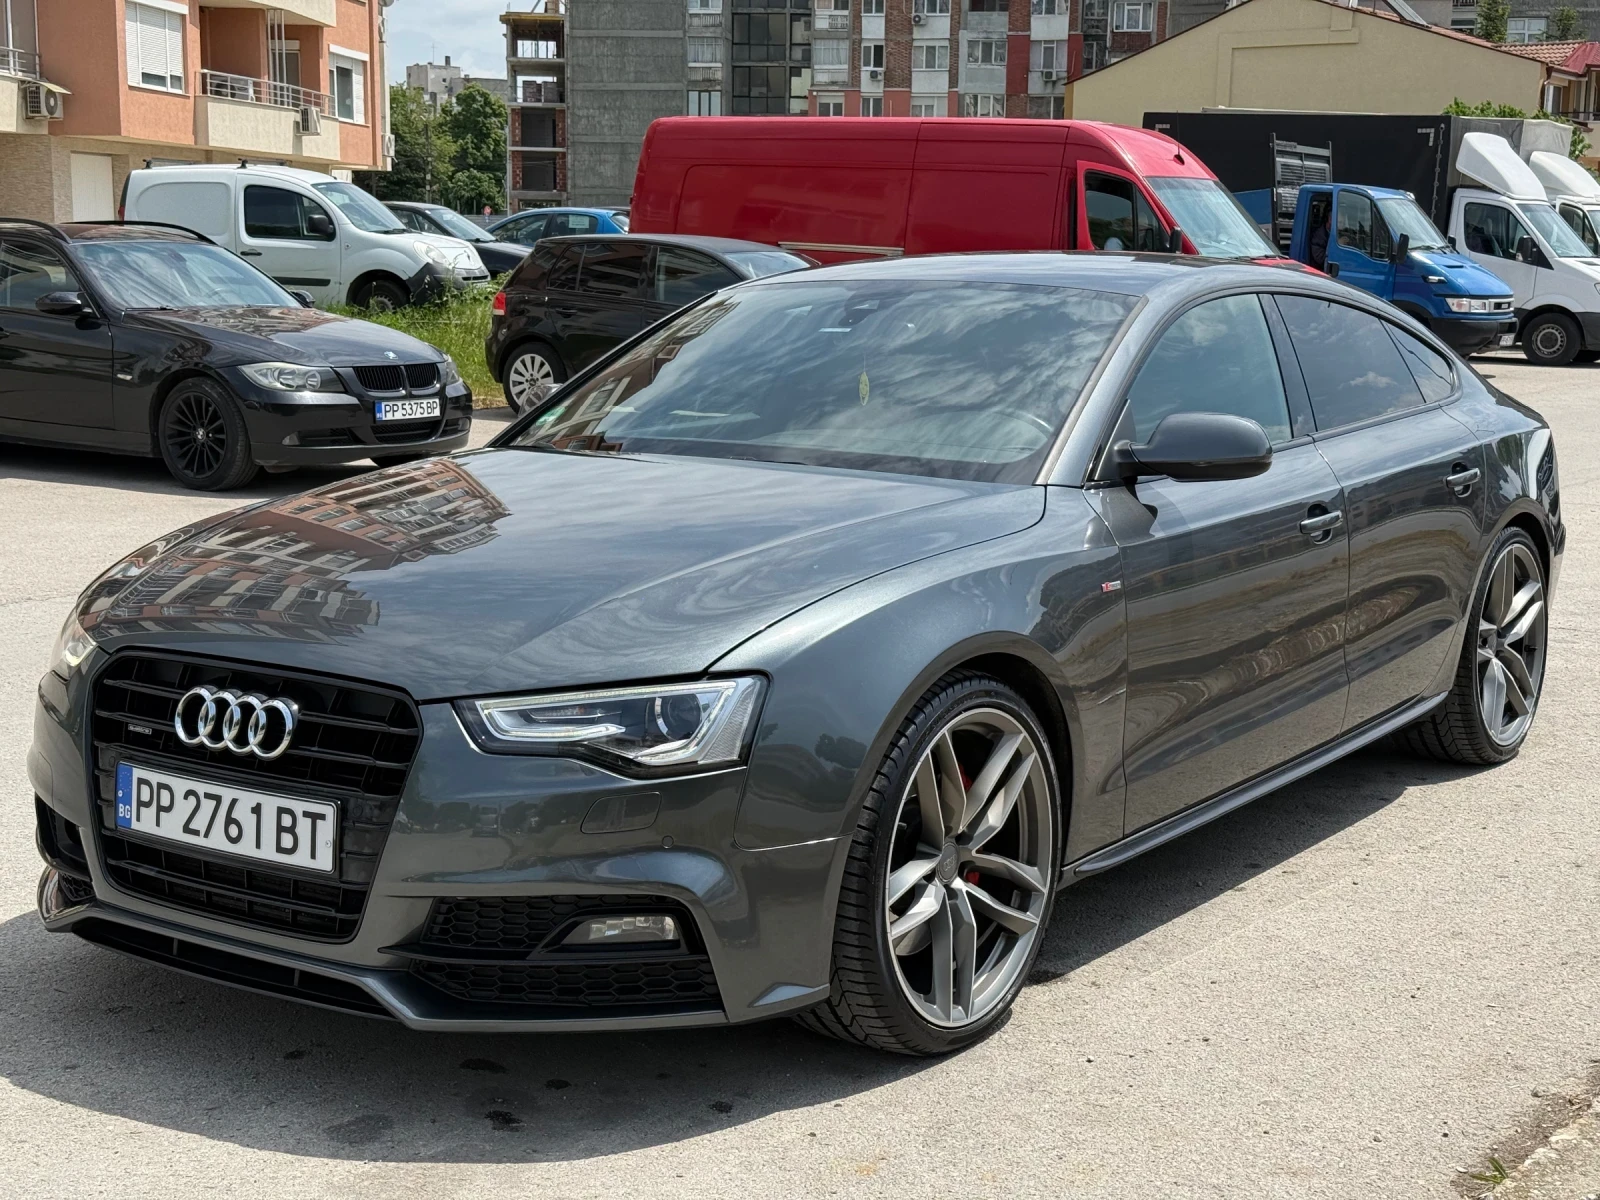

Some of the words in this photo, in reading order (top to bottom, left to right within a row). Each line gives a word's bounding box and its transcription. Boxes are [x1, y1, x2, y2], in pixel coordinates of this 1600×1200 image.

[384, 404, 399, 418] PP
[401, 402, 425, 416] 5375
[426, 401, 438, 415] BP
[118, 803, 131, 819] BG
[135, 776, 175, 828] PP
[182, 788, 262, 850] 2761
[275, 805, 327, 860] BT
